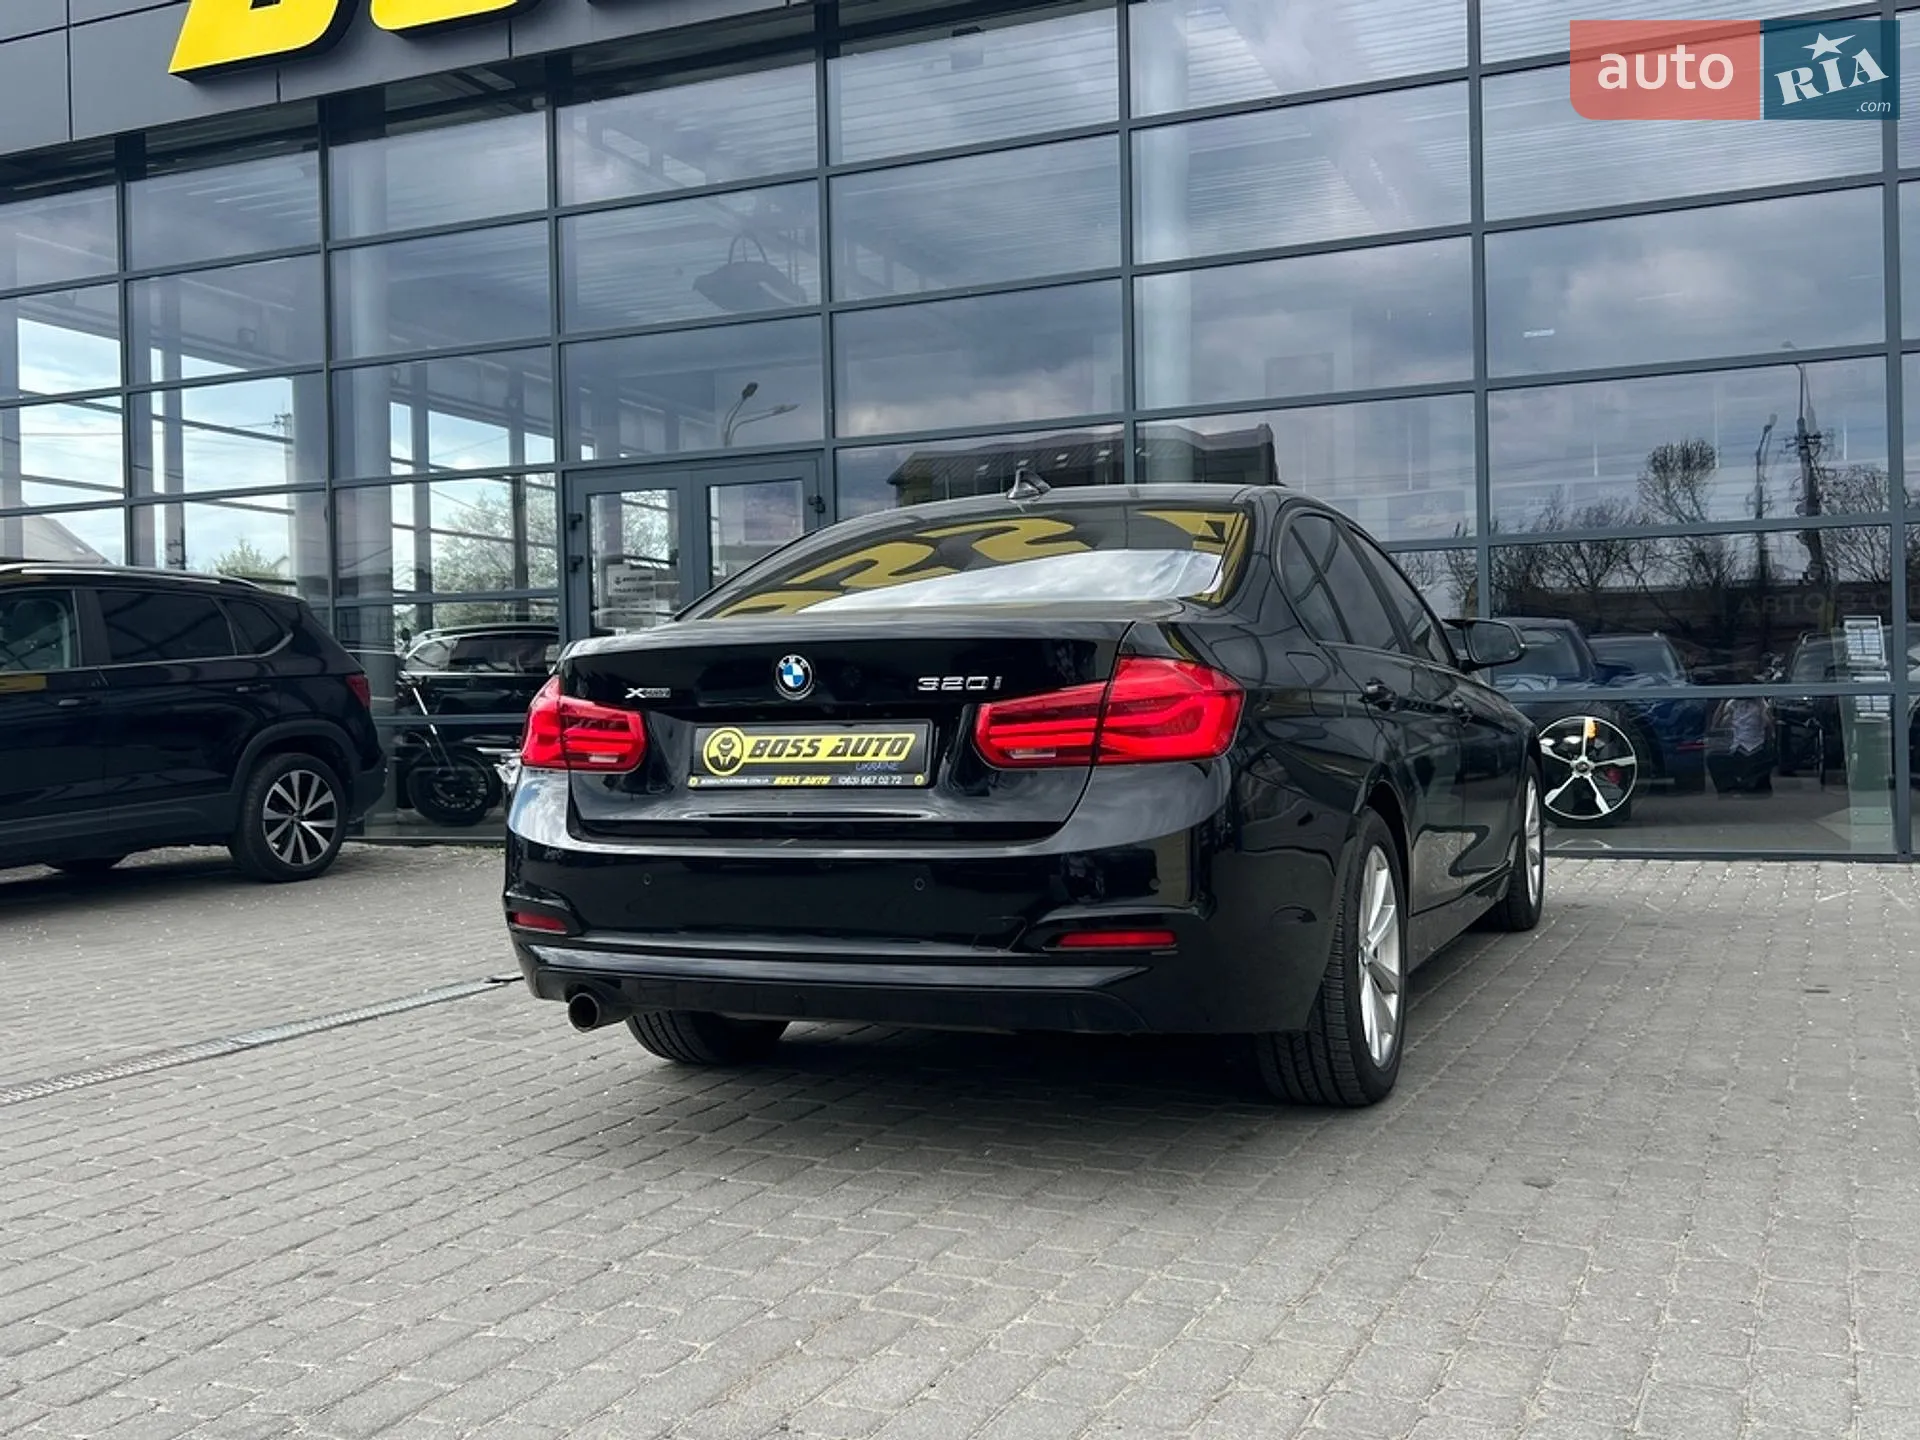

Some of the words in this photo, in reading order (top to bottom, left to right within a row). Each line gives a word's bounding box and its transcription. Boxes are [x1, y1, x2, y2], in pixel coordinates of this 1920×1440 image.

[748, 737, 822, 758] BOSS
[827, 736, 910, 757] AUTO
[855, 762, 899, 772] UKRAINE
[773, 775, 801, 786] BOSS
[801, 775, 832, 785] AUTO
[861, 775, 877, 786] 667
[878, 775, 889, 786] 02
[891, 775, 903, 785] 72
